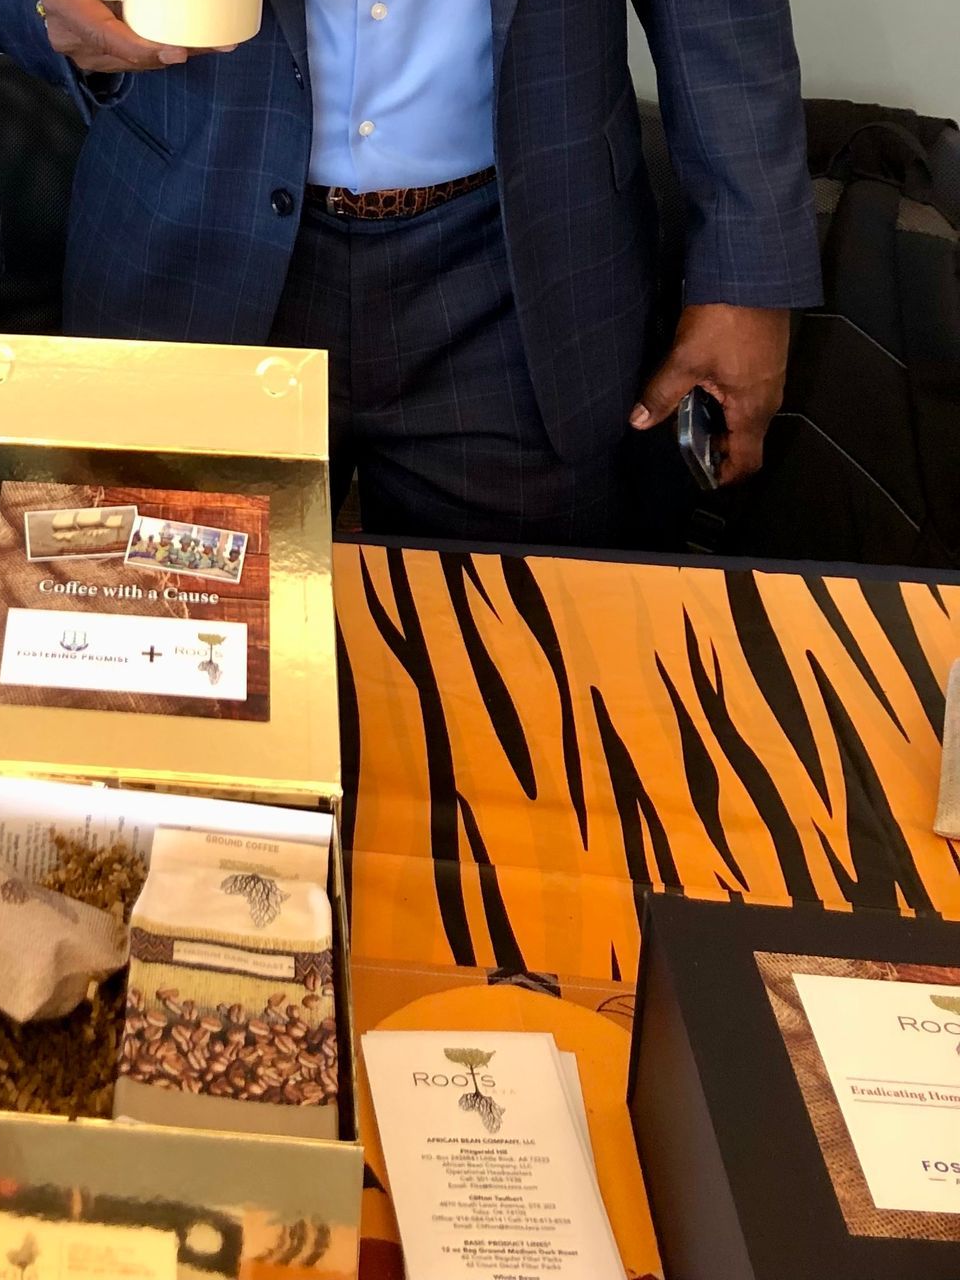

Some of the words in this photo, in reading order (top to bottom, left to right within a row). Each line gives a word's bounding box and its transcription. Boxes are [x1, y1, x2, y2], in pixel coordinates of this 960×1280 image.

[39, 579, 99, 596] Coffee
[103, 584, 144, 600] with
[147, 589, 158, 600] a
[163, 586, 220, 604] Cause
[16, 650, 78, 661] FOSTERING
[81, 655, 130, 664] PROMISE
[206, 834, 243, 848] GROUND
[245, 840, 280, 853] COFFEE
[412, 1071, 497, 1089] ROOTS
[850, 1084, 928, 1102] Eradicating
